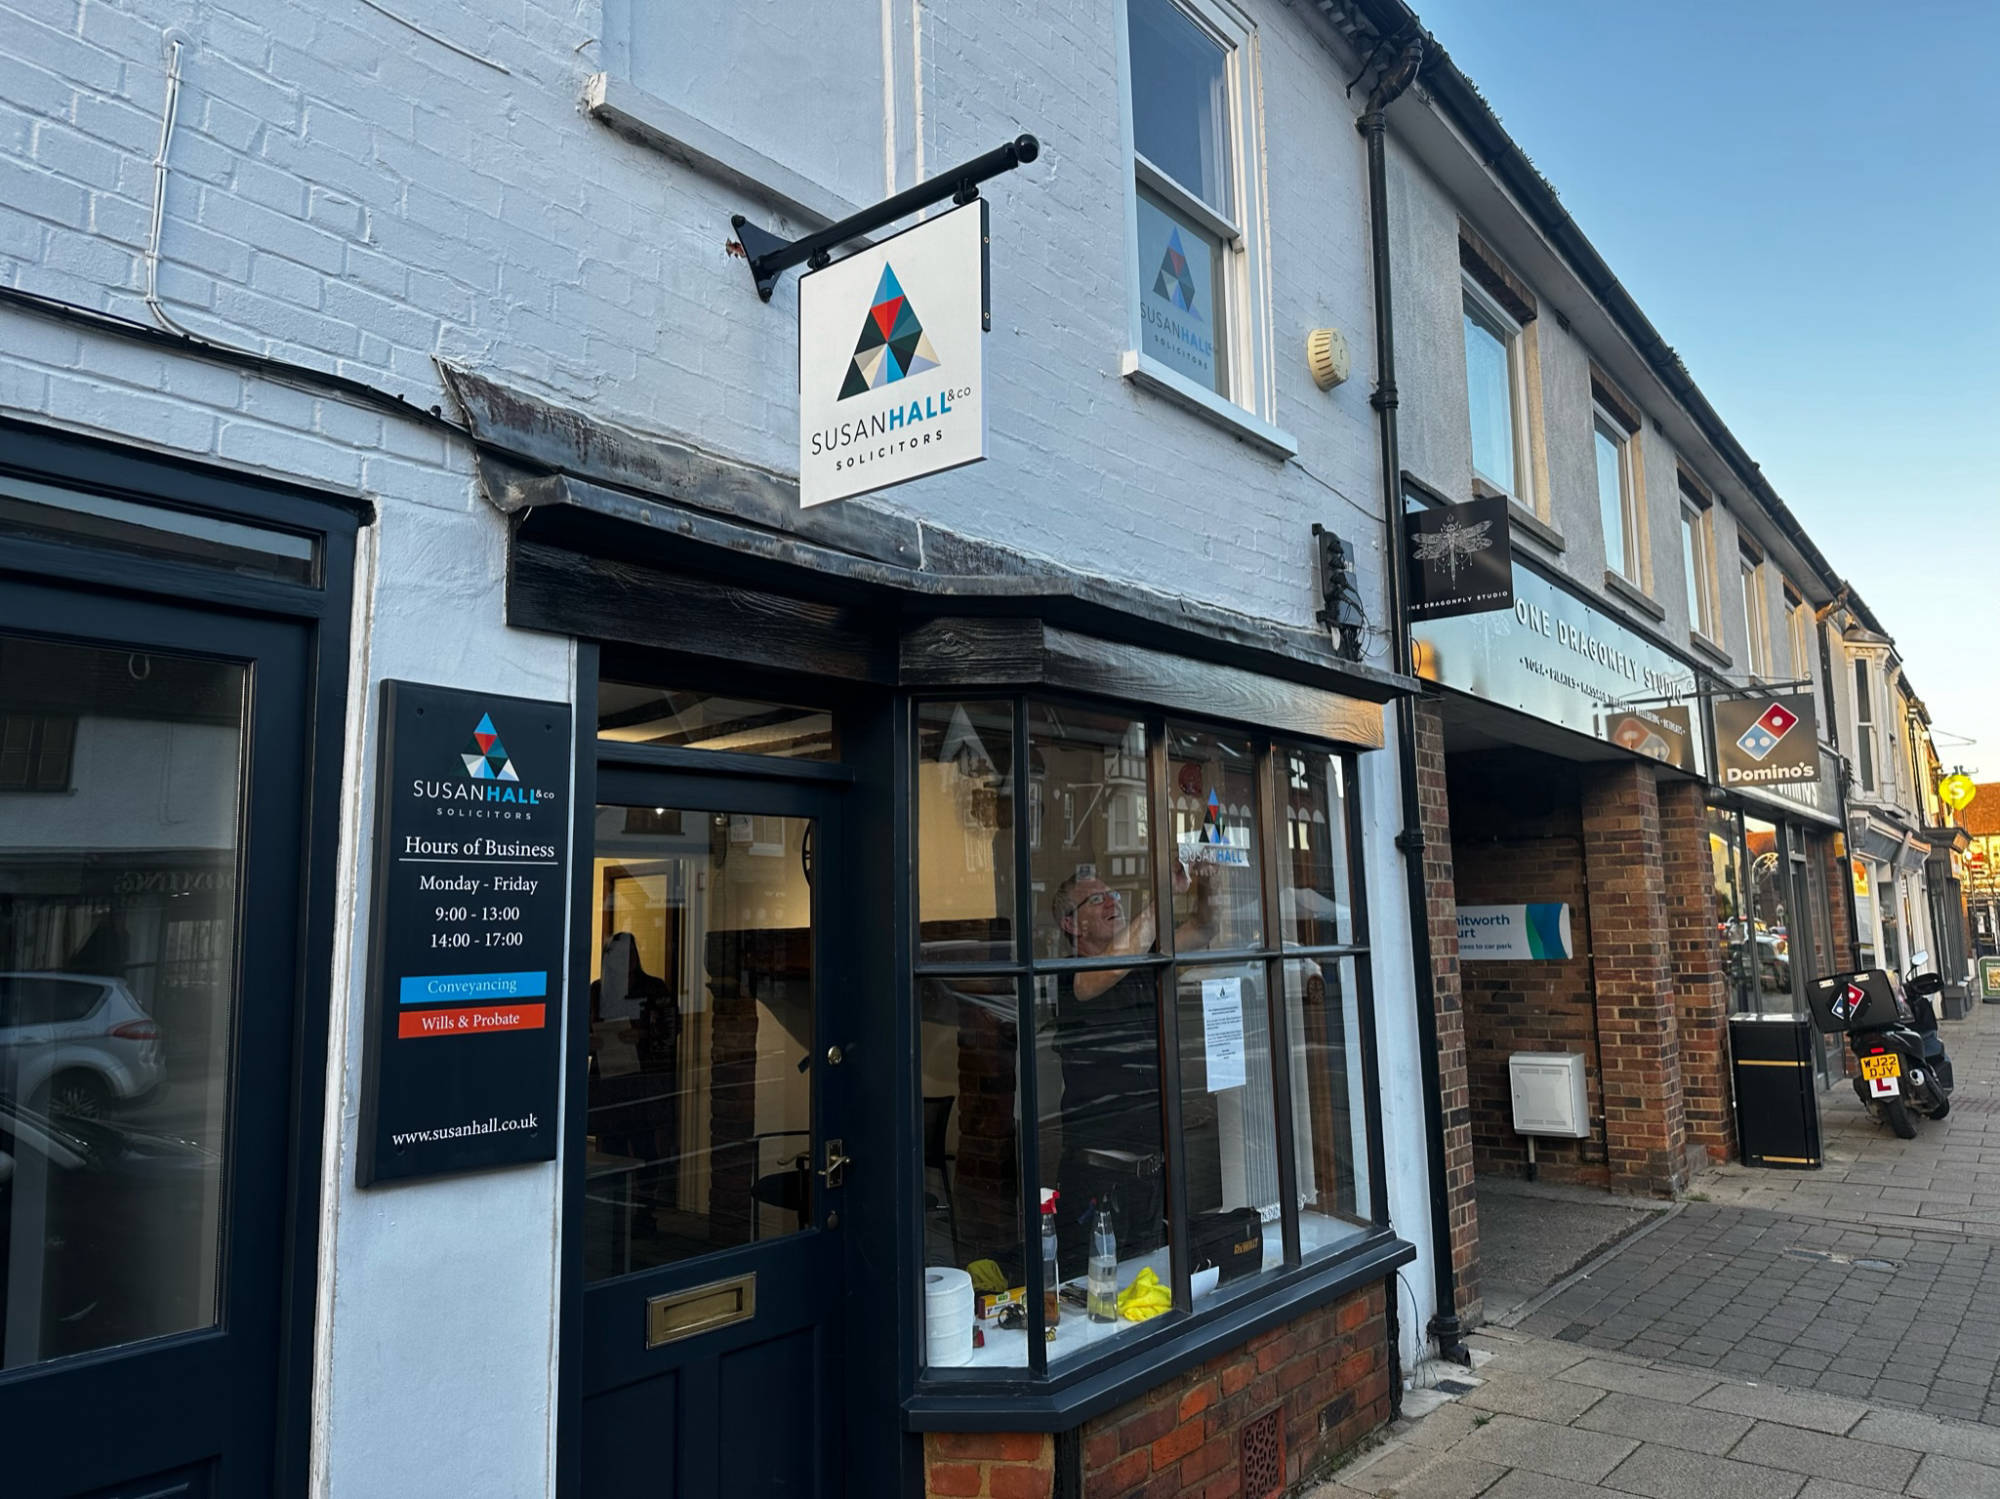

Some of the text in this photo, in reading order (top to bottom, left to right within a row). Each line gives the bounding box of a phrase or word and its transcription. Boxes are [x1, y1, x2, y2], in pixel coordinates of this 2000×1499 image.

[836, 430, 943, 471] SOLICITORS
[1424, 596, 1472, 609] DRAGONFLY
[1477, 590, 1508, 600] STUDIO
[1515, 597, 1683, 705] ONE DRAGONFLY STUDIO
[1727, 762, 1815, 782] Domino's
[1949, 782, 1965, 799] S
[436, 807, 532, 821] SOLICITORS
[405, 836, 555, 857] Hours of Business
[419, 875, 480, 895] Monday
[494, 876, 538, 895] Friday
[435, 906, 467, 922] 9:00
[481, 906, 520, 921] 13:00
[430, 933, 470, 948] 14:00
[485, 932, 523, 946] 17:00
[427, 978, 517, 995] Conveyancing
[421, 1012, 520, 1031] Wills & Probate
[1863, 1056, 1896, 1068] WJ22
[1869, 1066, 1893, 1077] DJY
[1875, 1078, 1892, 1092] L
[392, 1112, 538, 1145] www.susanhall.co.uk
